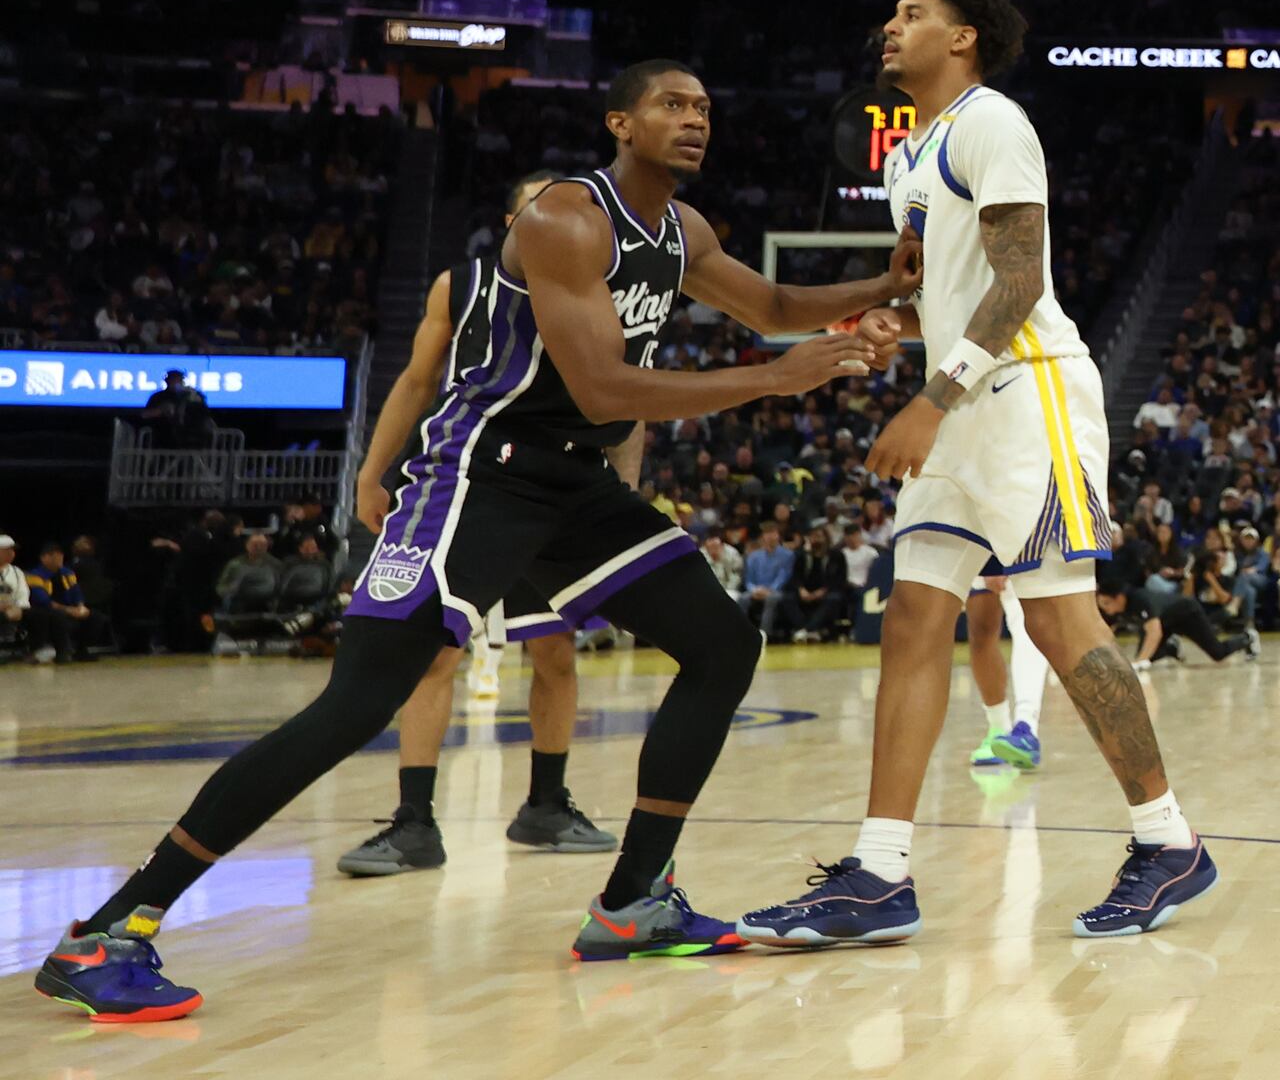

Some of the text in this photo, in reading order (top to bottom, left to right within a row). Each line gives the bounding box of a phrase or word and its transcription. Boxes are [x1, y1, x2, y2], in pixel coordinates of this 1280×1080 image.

[1048, 47, 1137, 67] CACHE
[1140, 47, 1222, 68] CREEK
[864, 105, 917, 130] 7:17
[371, 566, 420, 582] KINGS
